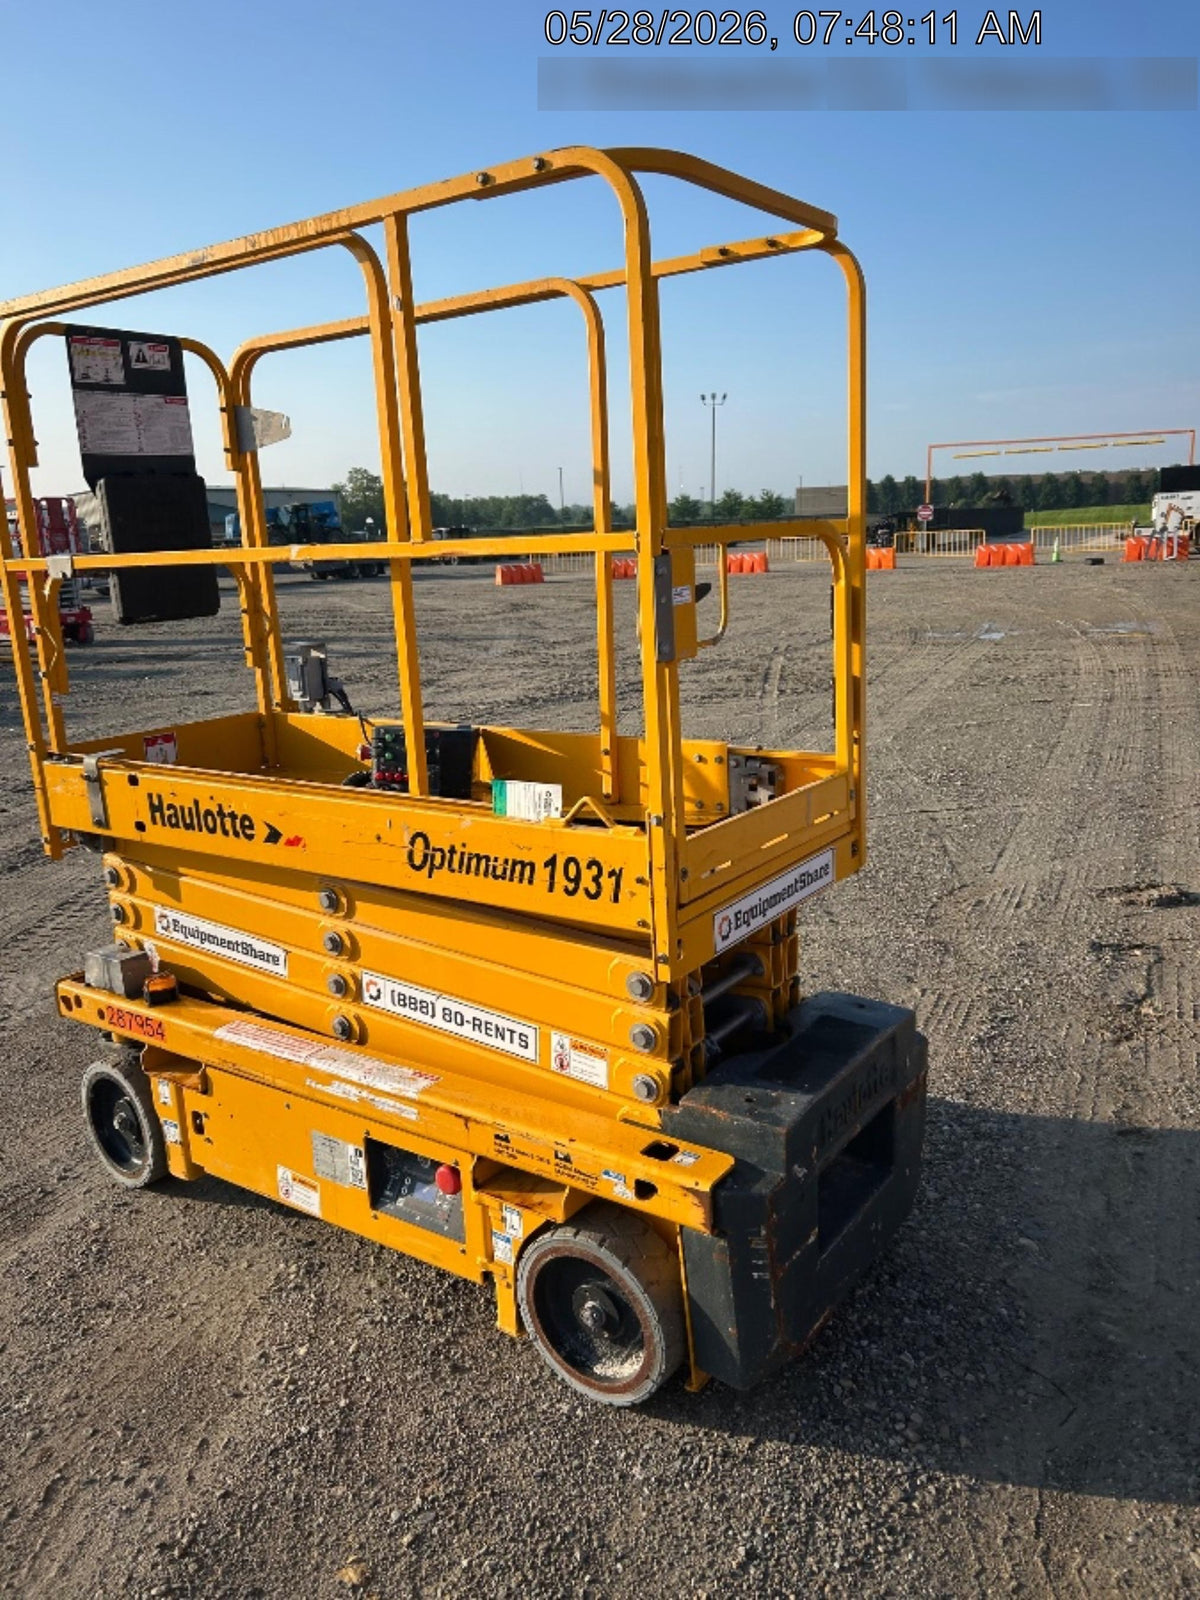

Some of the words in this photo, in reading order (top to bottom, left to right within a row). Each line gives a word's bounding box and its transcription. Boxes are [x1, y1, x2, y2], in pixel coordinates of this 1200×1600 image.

[147, 792, 255, 841] Haulotte
[407, 832, 536, 879] Optimum
[543, 853, 624, 903] 1931
[734, 863, 830, 930] EquipmentShare
[172, 918, 280, 966] EquipmentShare
[106, 1005, 166, 1040] 287954
[390, 989, 436, 1019] (888)
[442, 1007, 529, 1049] 80-RENTS
